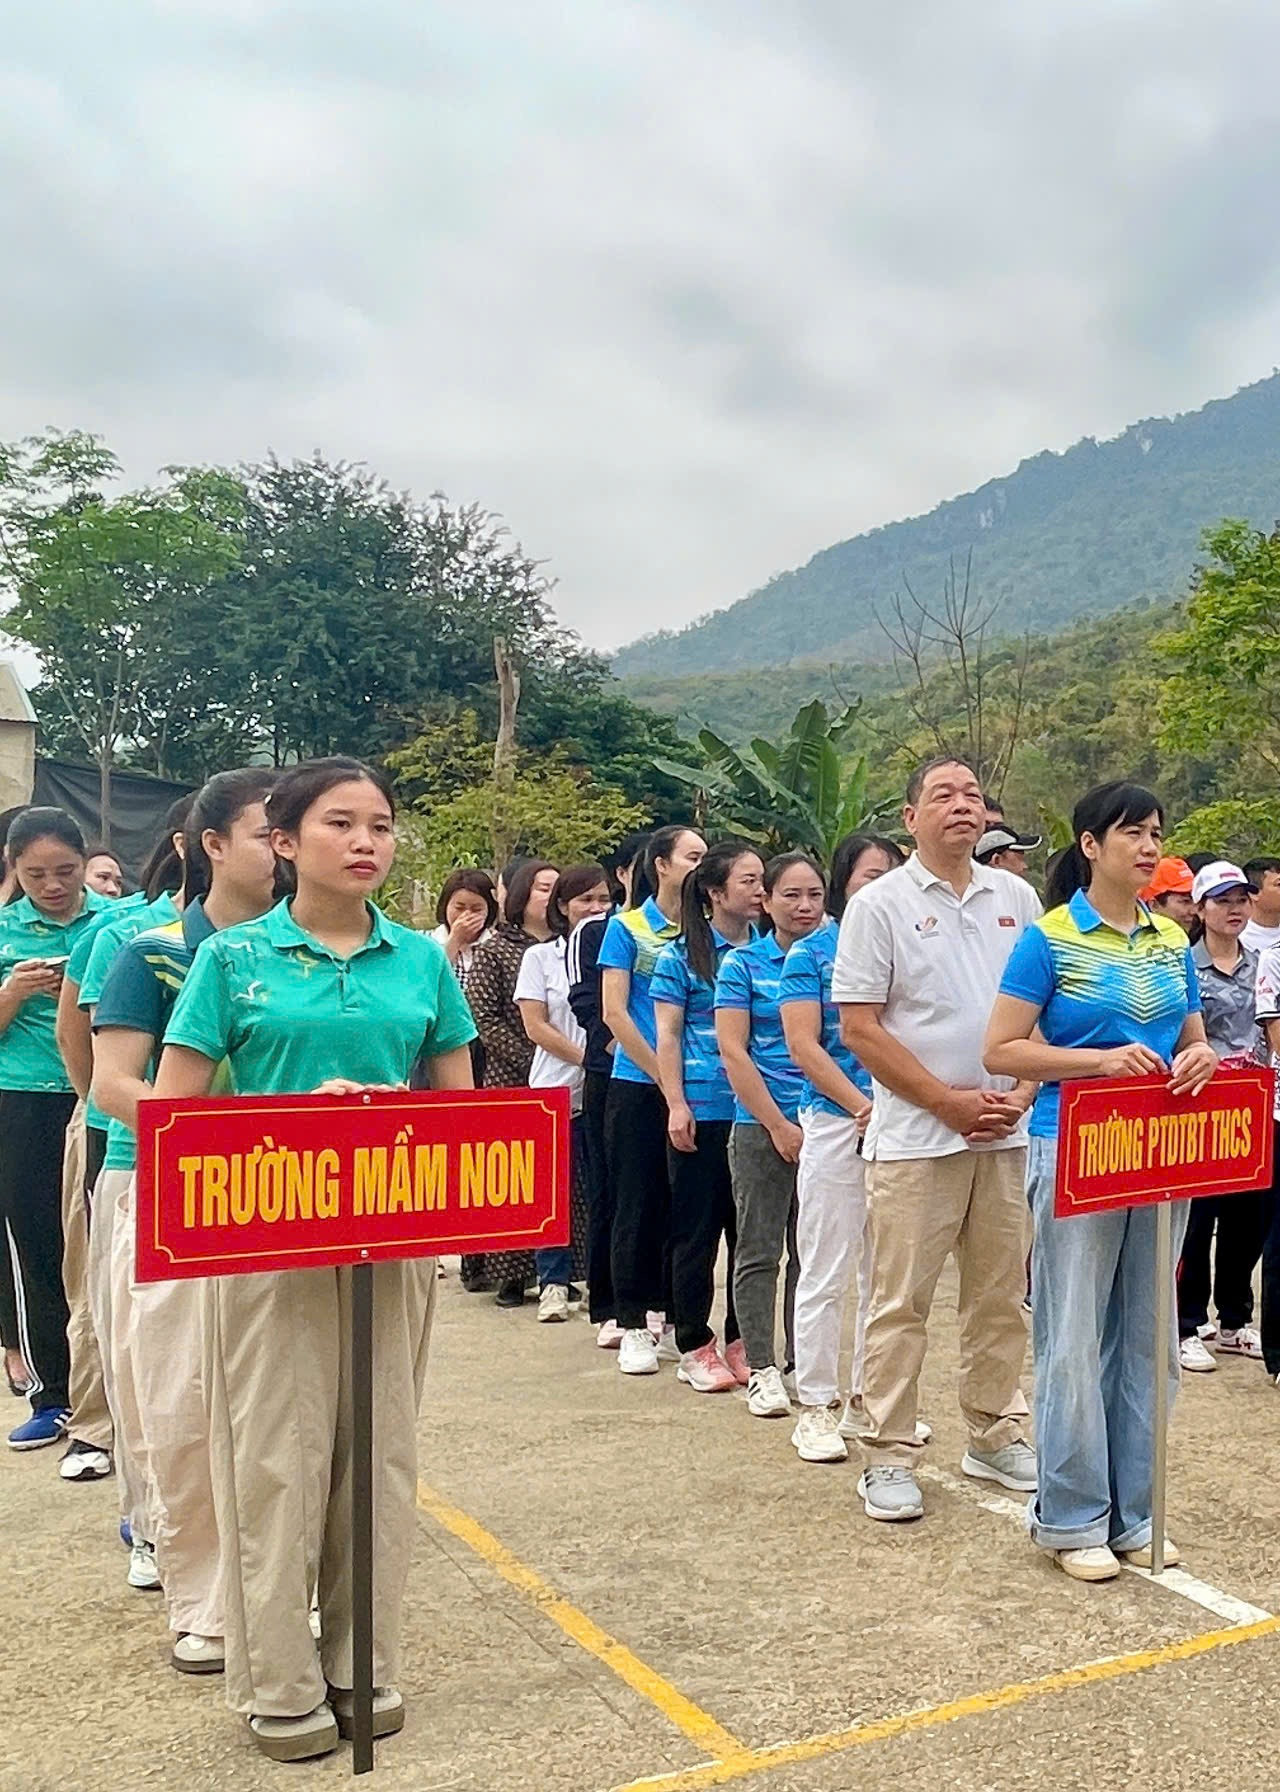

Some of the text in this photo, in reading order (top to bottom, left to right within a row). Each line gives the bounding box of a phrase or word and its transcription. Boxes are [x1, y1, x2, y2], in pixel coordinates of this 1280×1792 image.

[178, 1124, 535, 1228] TRƯỜNG MẦM NON
[1078, 1107, 1252, 1178] TRƯỜNG PTDTBT THCS
